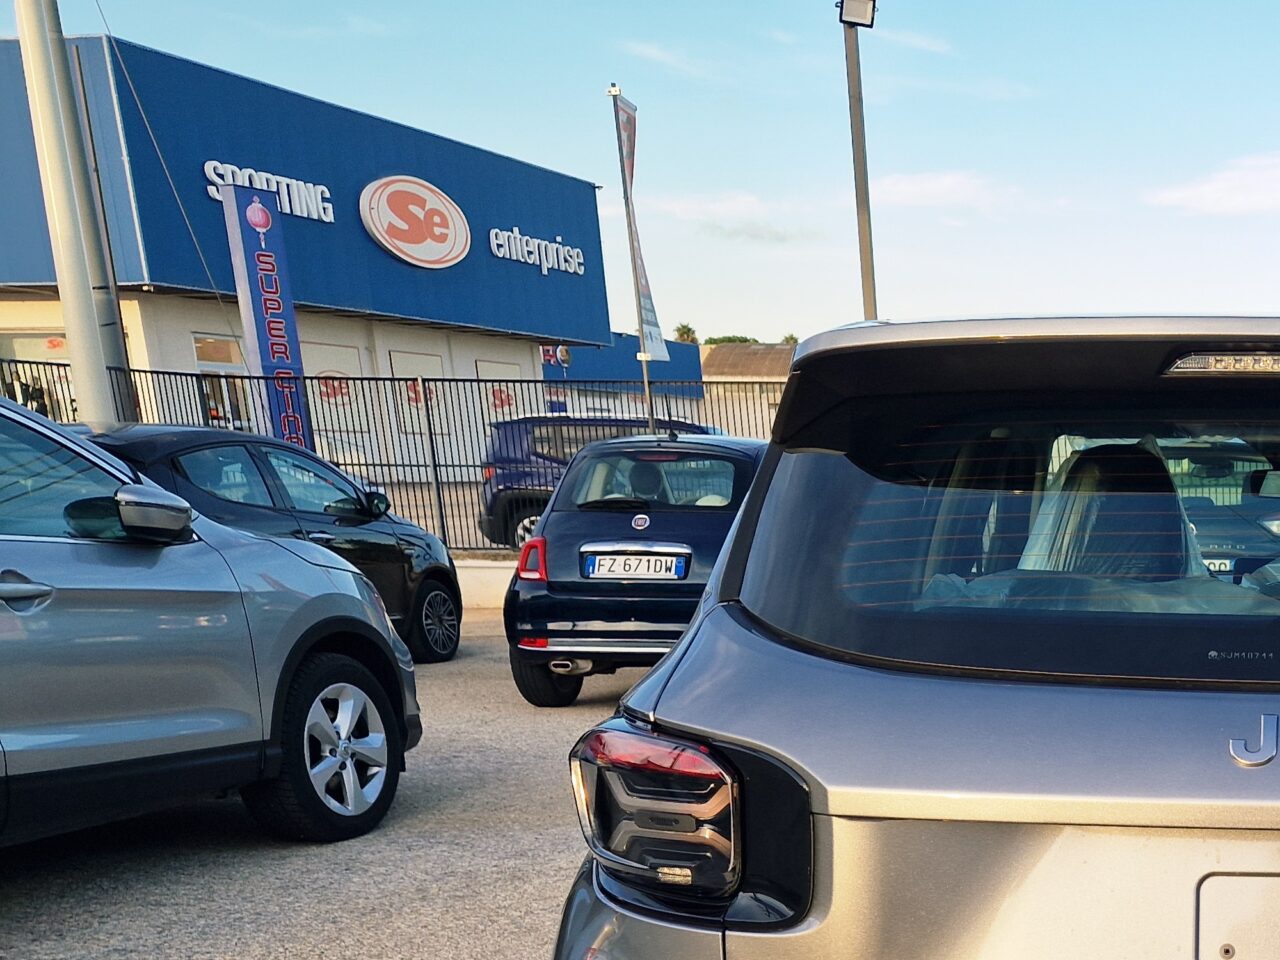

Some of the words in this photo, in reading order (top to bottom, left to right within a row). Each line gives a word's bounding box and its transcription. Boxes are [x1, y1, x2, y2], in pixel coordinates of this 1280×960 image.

[386, 190, 450, 245] Se
[490, 227, 585, 276] enterprise
[255, 251, 291, 363] SUPER
[597, 558, 617, 573] FZ
[623, 558, 674, 573] 671DW
